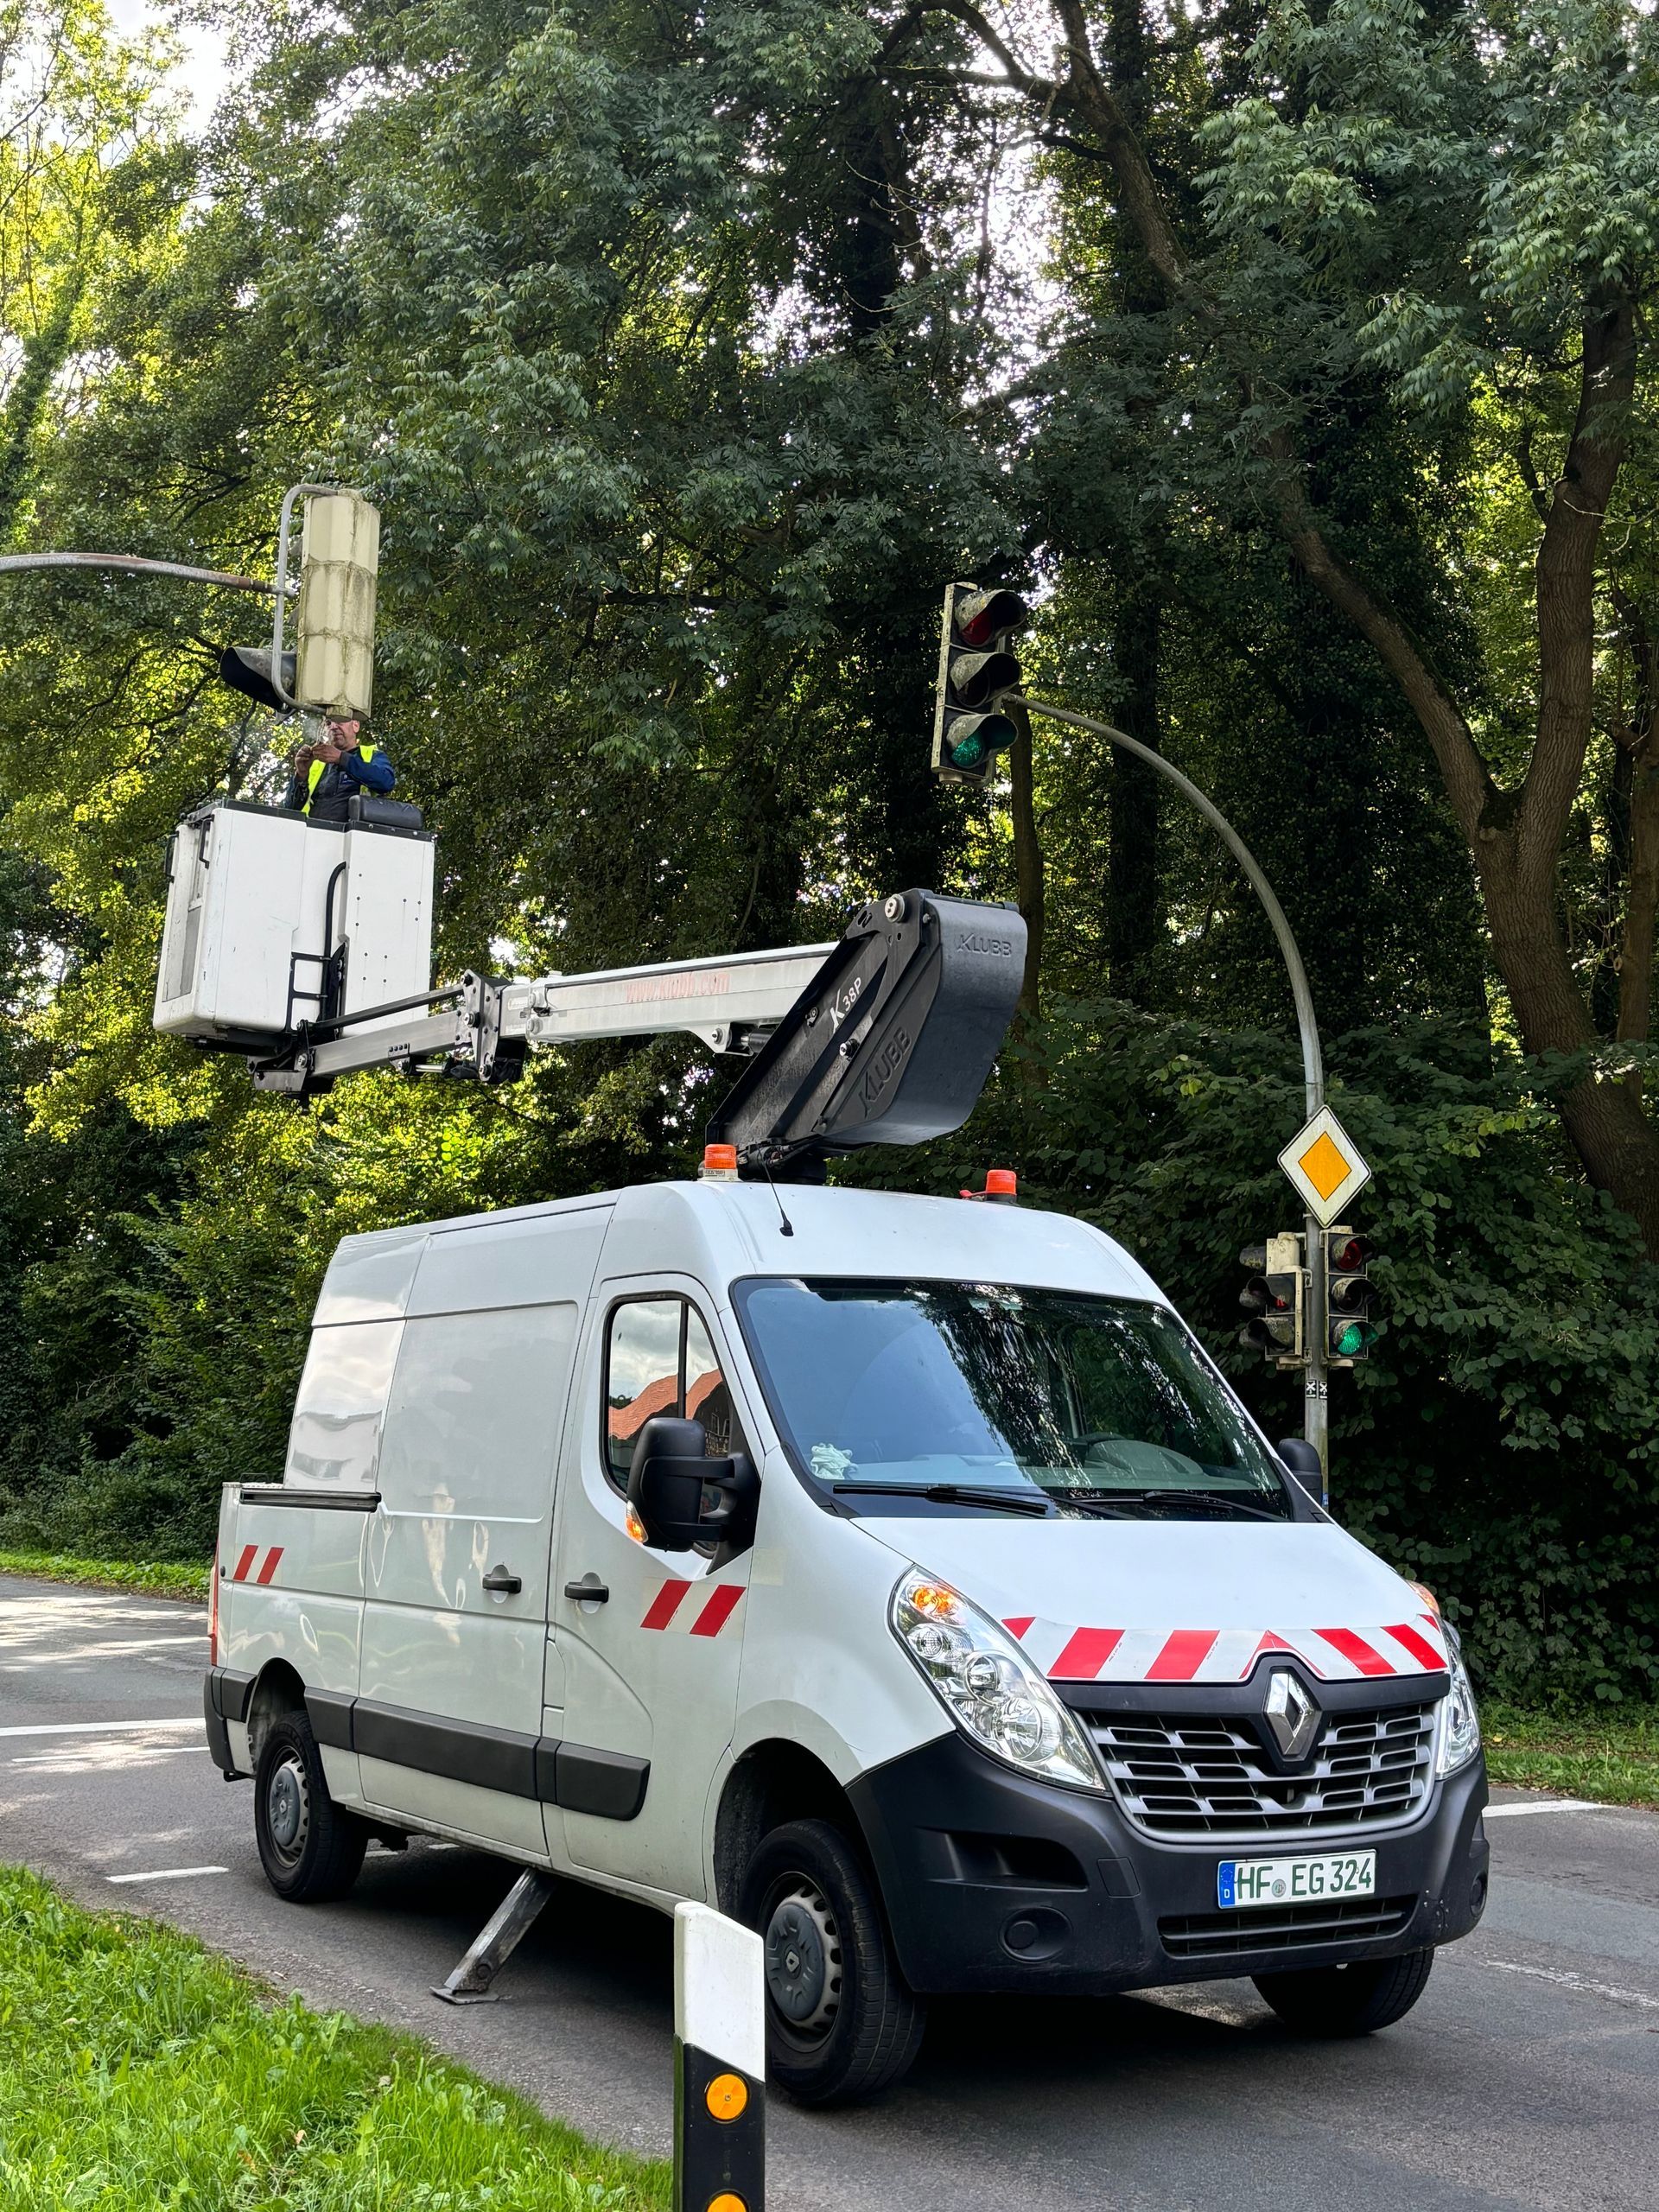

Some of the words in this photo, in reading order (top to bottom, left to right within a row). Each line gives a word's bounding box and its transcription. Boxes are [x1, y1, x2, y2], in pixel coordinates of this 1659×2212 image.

[957, 932, 1012, 958] KLUBB
[859, 1026, 912, 1119] KLUBB
[1224, 1889, 1230, 1898] D
[1237, 1866, 1273, 1899] HF
[1292, 1862, 1324, 1896] EG
[1330, 1858, 1371, 1892] 324
